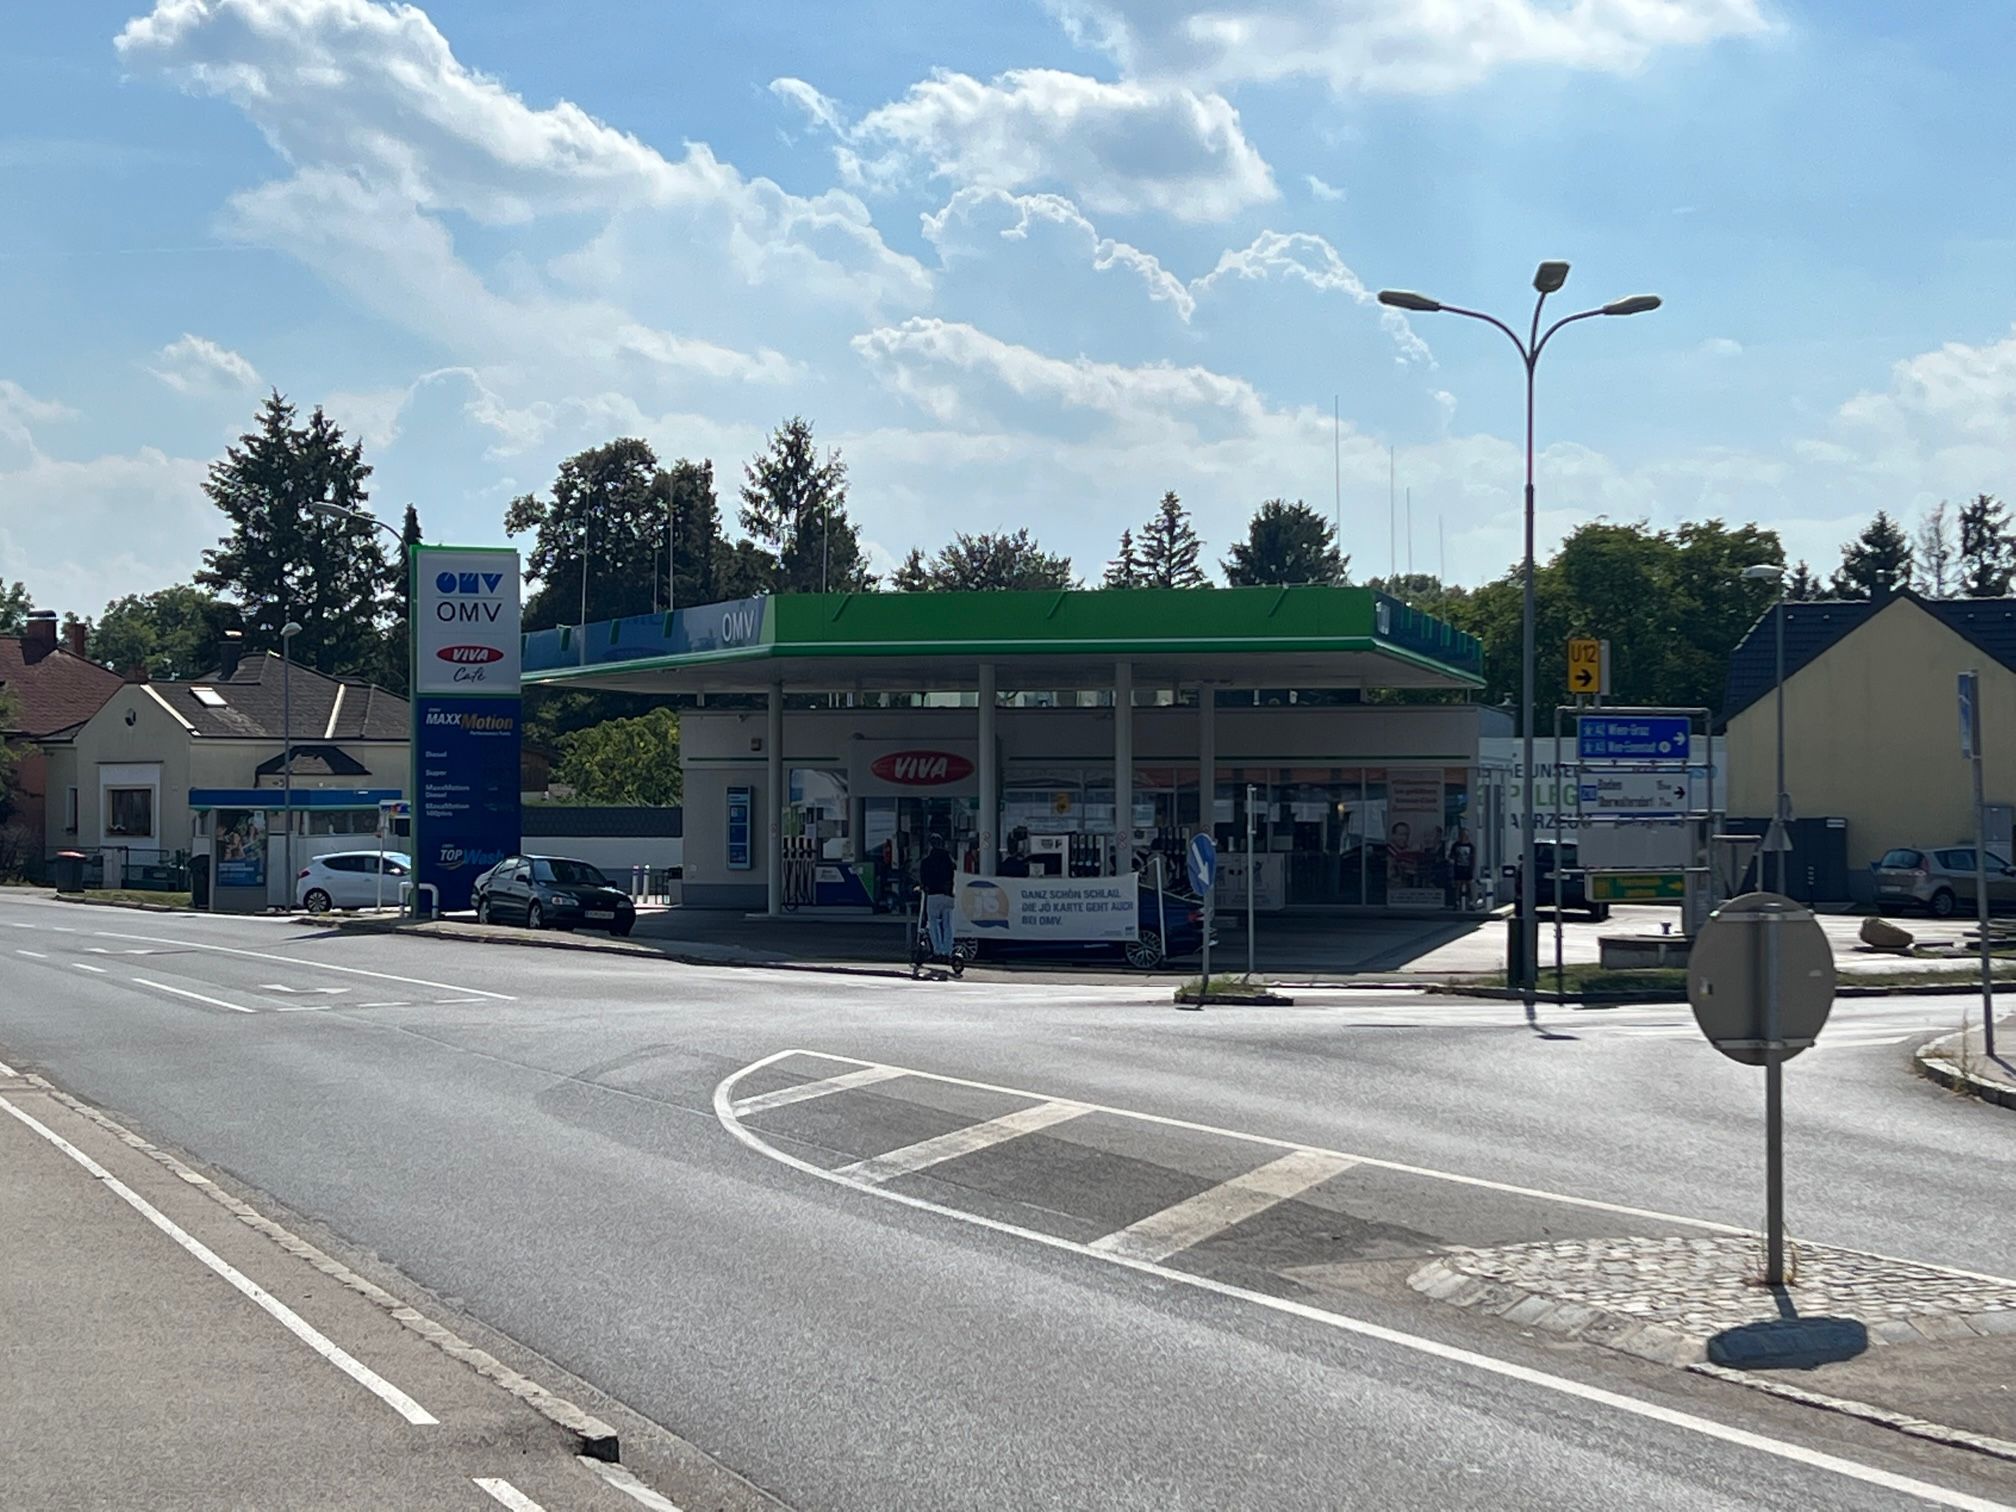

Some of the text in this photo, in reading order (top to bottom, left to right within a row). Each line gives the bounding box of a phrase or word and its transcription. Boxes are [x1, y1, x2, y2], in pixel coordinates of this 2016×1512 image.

[436, 601, 502, 622] OMV
[722, 610, 755, 642] OMV
[452, 647, 490, 661] VIVA
[1570, 643, 1597, 663] U12
[453, 666, 487, 683] Café
[894, 756, 949, 779] VIVA
[1021, 889, 1048, 900] GANZ
[1050, 888, 1082, 900] SCHÖN
[1021, 902, 1037, 913] DIE
[1053, 901, 1084, 913] KARTE
[1085, 901, 1109, 912] GEHT
[1110, 900, 1134, 912] AUCH
[1021, 916, 1037, 926] BEI
